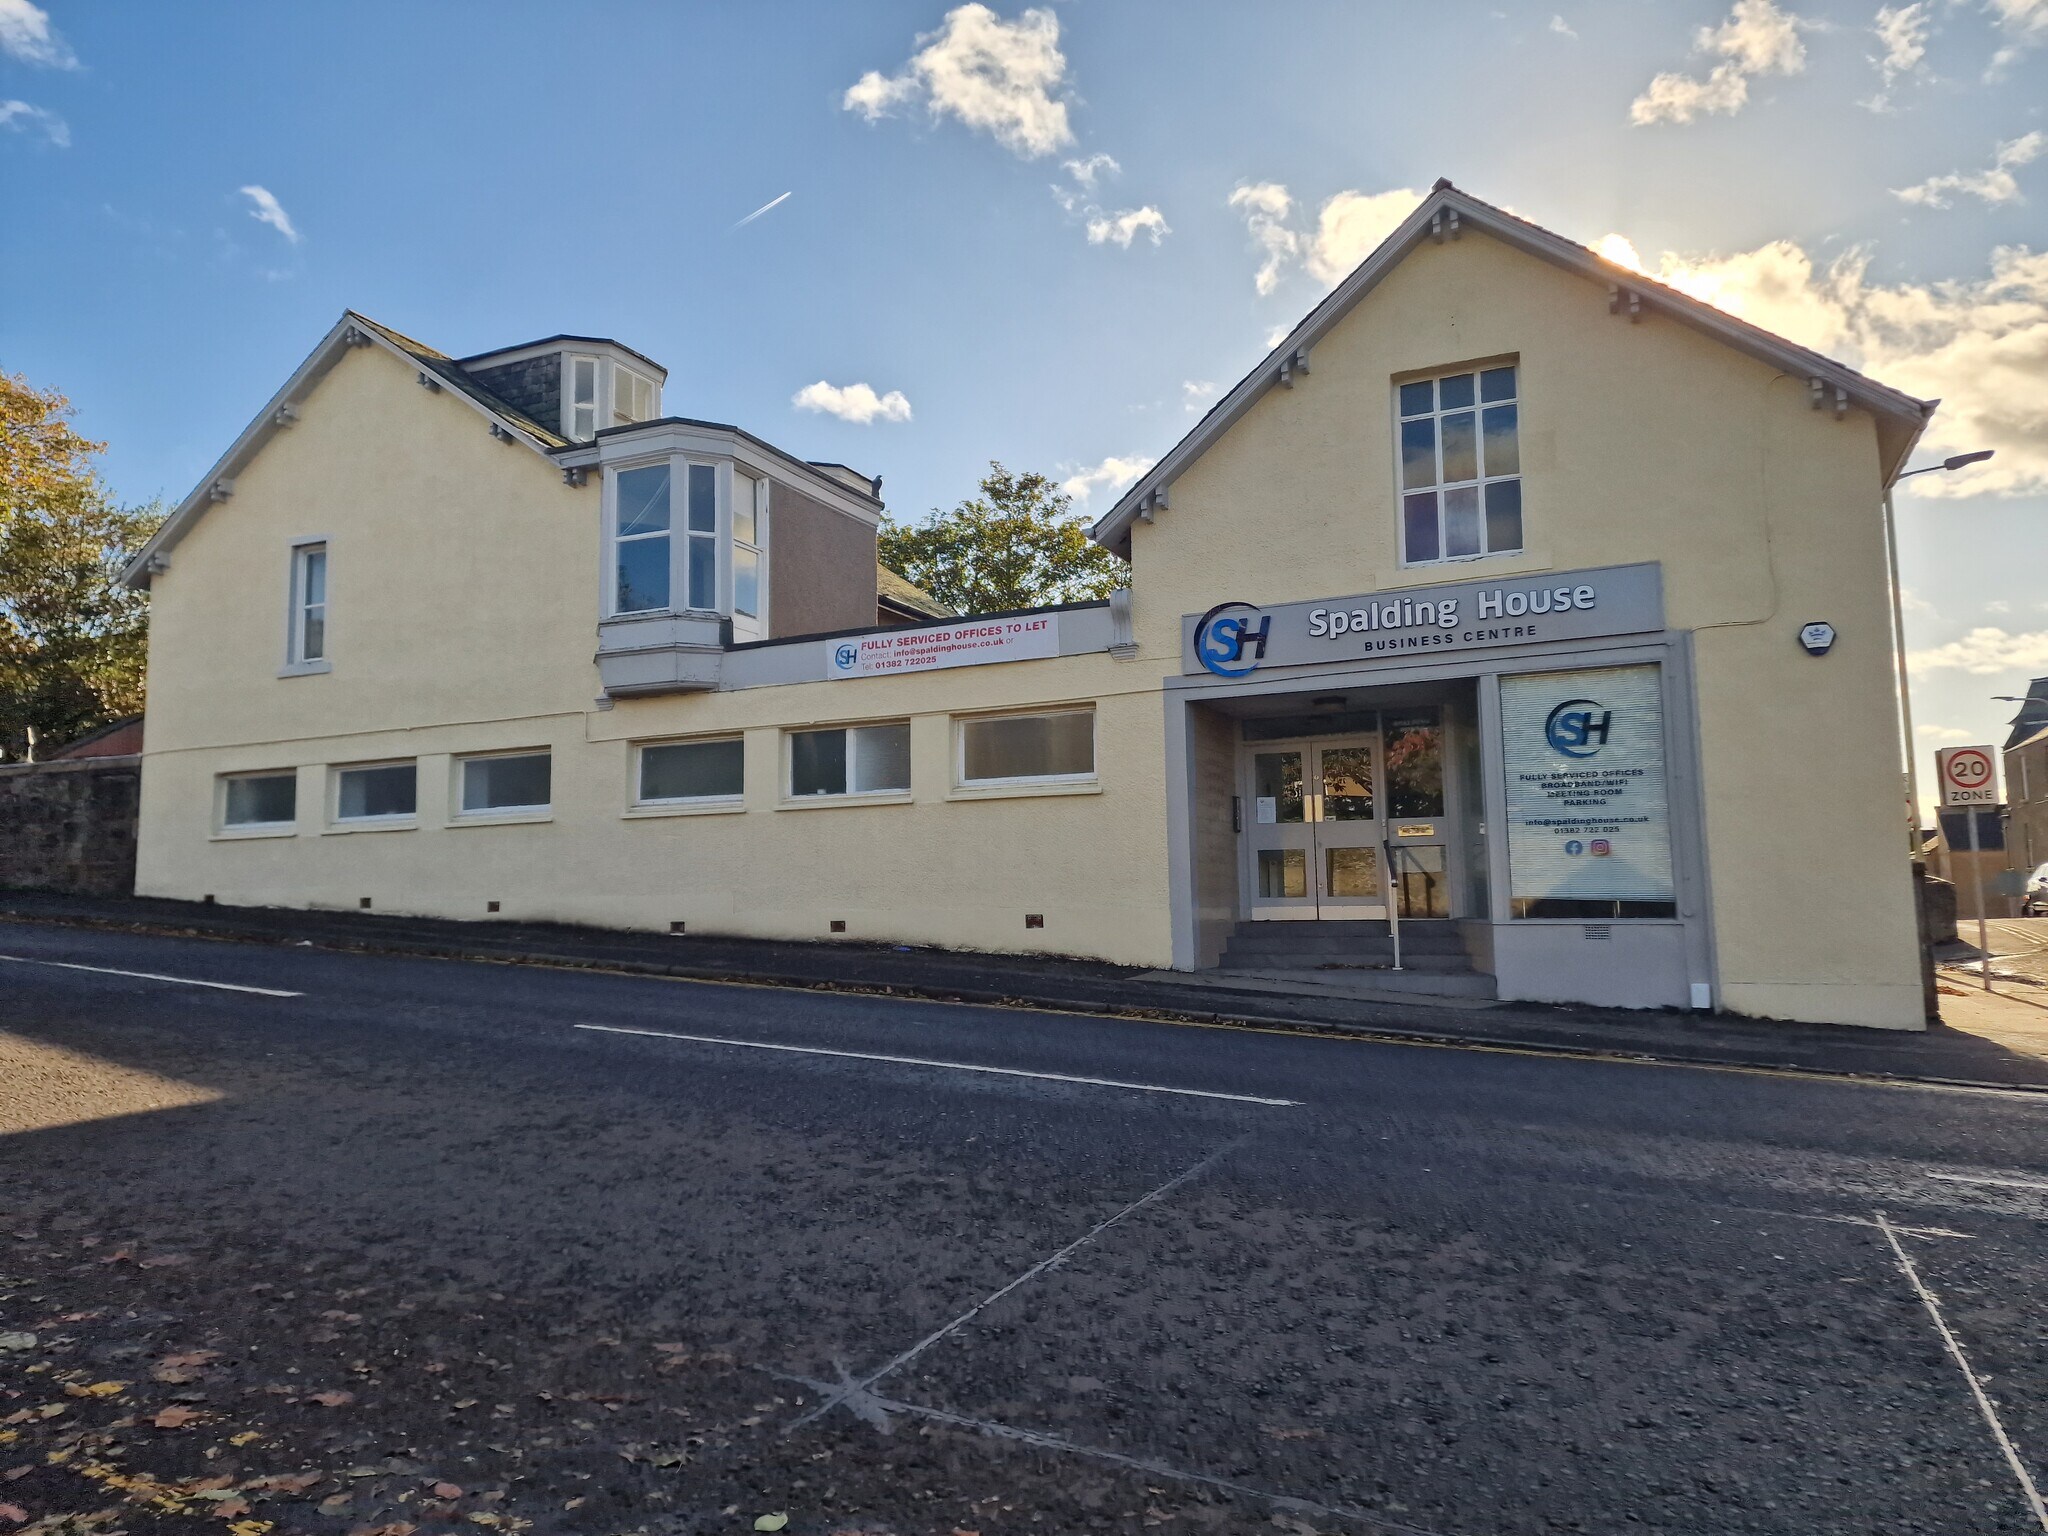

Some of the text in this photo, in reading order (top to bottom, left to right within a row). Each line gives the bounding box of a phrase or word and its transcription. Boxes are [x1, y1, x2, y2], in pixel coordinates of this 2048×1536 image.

[1308, 584, 1596, 640] Spalding House
[861, 620, 1048, 651] FULLY SERVICED OFFICES TO LET
[1206, 614, 1272, 662] SH
[1364, 625, 1537, 652] BUSINESS CENTRE
[838, 647, 858, 666] SH
[860, 651, 892, 661] Contact:
[893, 637, 1004, 658] info@spaldinghouse.co.uk
[862, 655, 937, 671] Tel: 01382 722025
[1554, 710, 1612, 746] SH
[1520, 768, 1644, 781] FULLY SERVICED OFFICES
[1953, 760, 1985, 778] 20
[1594, 788, 1623, 796] ROOM
[1951, 789, 1993, 801] ZONE
[1563, 798, 1607, 806] PARKING
[1554, 827, 1580, 835] 01382
